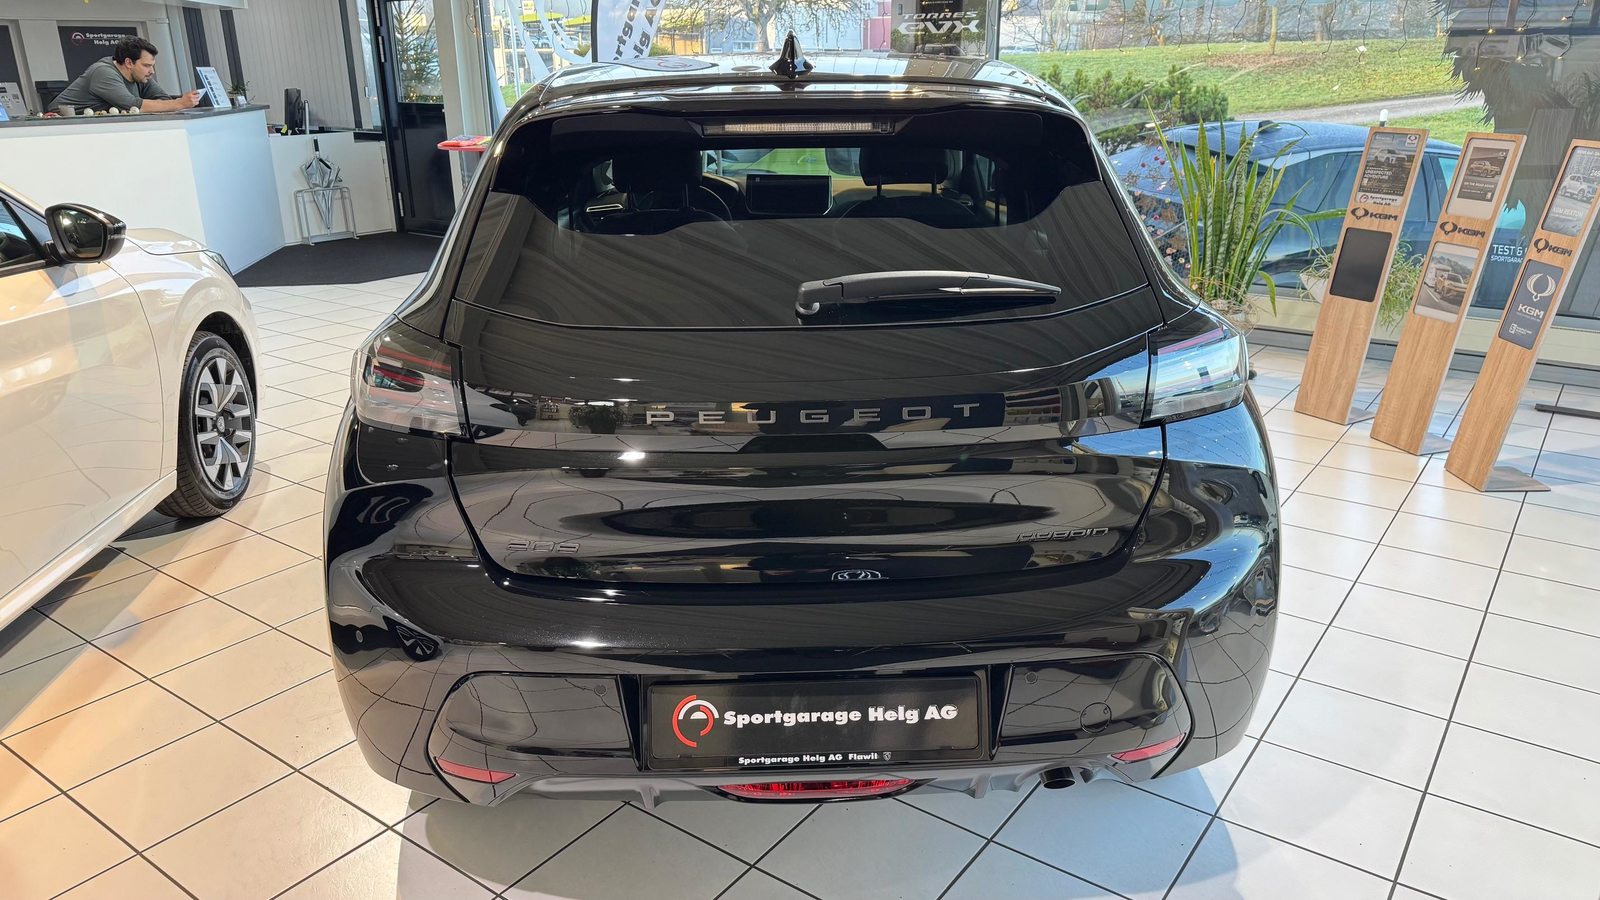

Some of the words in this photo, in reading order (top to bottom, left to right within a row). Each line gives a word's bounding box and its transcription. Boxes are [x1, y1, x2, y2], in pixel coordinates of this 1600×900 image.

[902, 11, 979, 20] TORRES
[1369, 211, 1399, 221] KGM
[1457, 226, 1486, 238] KGM
[1492, 244, 1516, 255] TEST
[1516, 246, 1523, 256] &
[1548, 245, 1573, 257] KGM
[1517, 303, 1545, 319] KGM
[645, 402, 981, 425] PEUGEOT
[1016, 527, 1109, 543] HYBRID
[506, 539, 581, 554] 208
[723, 709, 862, 729] Sportgarage
[867, 705, 919, 725] Helg
[924, 704, 959, 721] AG
[738, 754, 801, 765] Sportgarage
[802, 754, 826, 765] Helg
[828, 753, 843, 762] AG
[848, 752, 878, 761] Flawil
